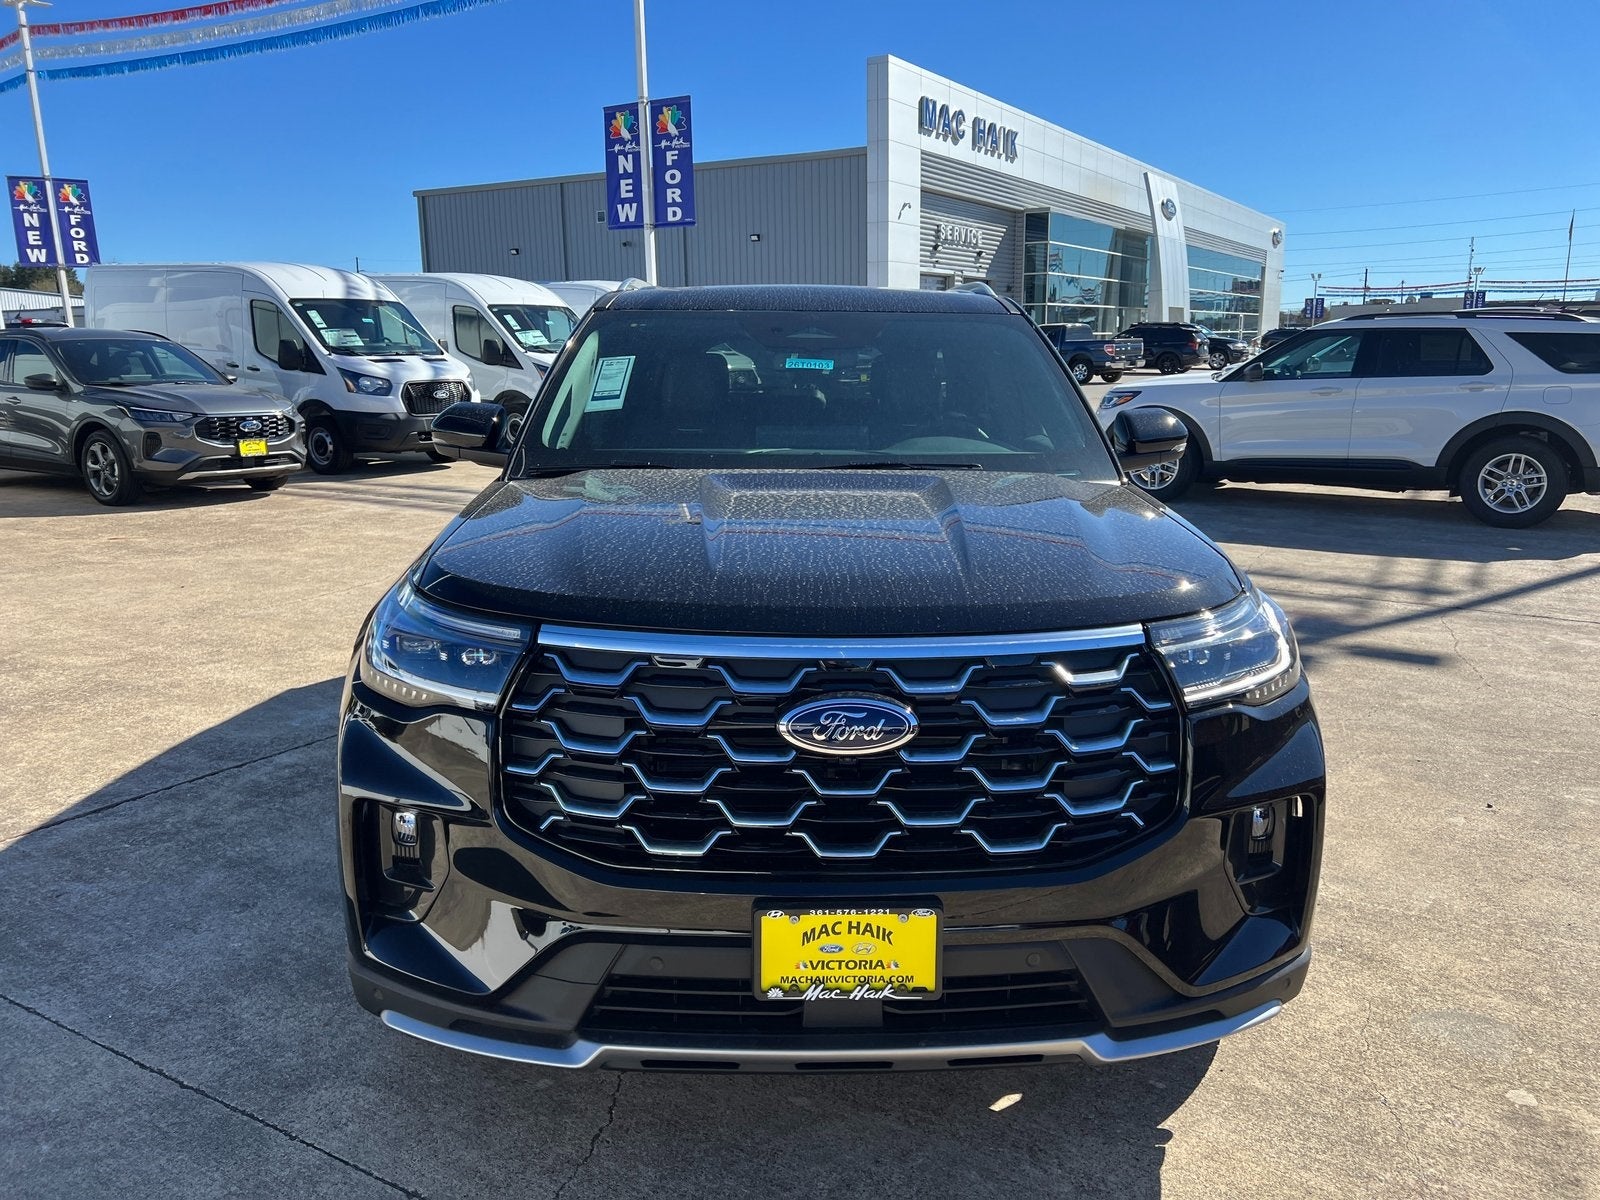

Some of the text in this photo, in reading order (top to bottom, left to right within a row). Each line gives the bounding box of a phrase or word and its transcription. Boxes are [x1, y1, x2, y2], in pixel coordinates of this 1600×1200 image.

[920, 97, 1018, 161] MAC HAIK
[617, 154, 637, 223] NEW
[664, 150, 683, 222] FORD
[23, 213, 47, 263] NEW
[69, 214, 90, 264] FORD
[940, 223, 983, 244] SERVICE
[812, 710, 885, 742] Ford
[802, 920, 894, 946] MAC HAIK
[780, 975, 914, 984] MACHAIKVICTORIA.COM
[809, 959, 885, 971] VICTORIA
[802, 983, 898, 1000] Mac Haik
